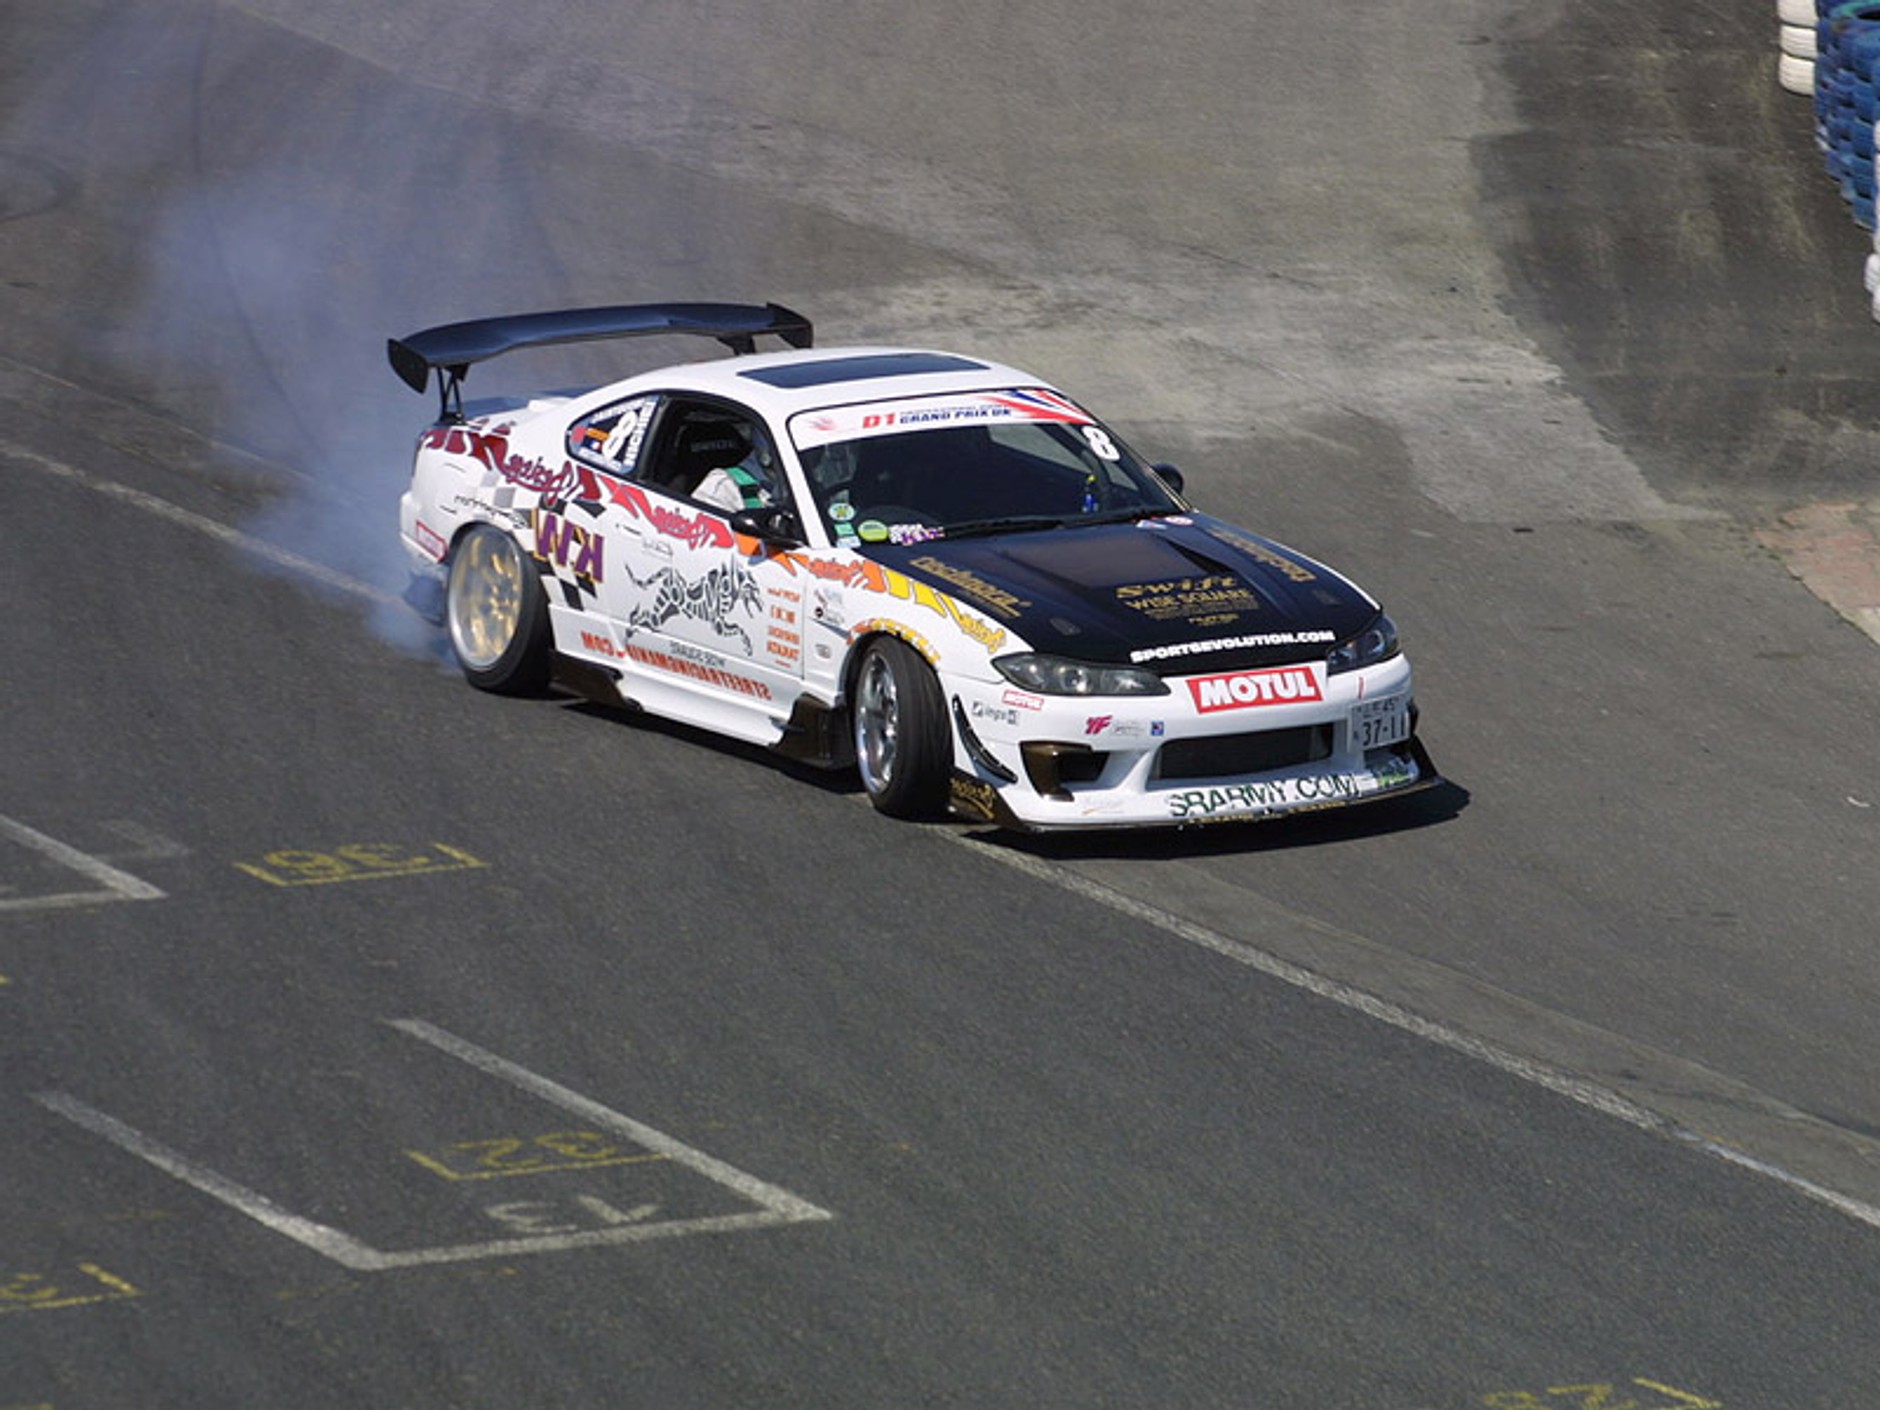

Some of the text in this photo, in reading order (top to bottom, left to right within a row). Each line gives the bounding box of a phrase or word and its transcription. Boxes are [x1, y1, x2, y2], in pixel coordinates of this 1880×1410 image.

[602, 411, 637, 460] 8
[862, 412, 896, 429] D1
[899, 411, 951, 425] GRAND
[955, 408, 989, 420] PRIX
[1081, 425, 1121, 462] 8
[1130, 630, 1336, 663] SPORTSEVOLUTION.COM
[1200, 672, 1316, 707] MOTUL
